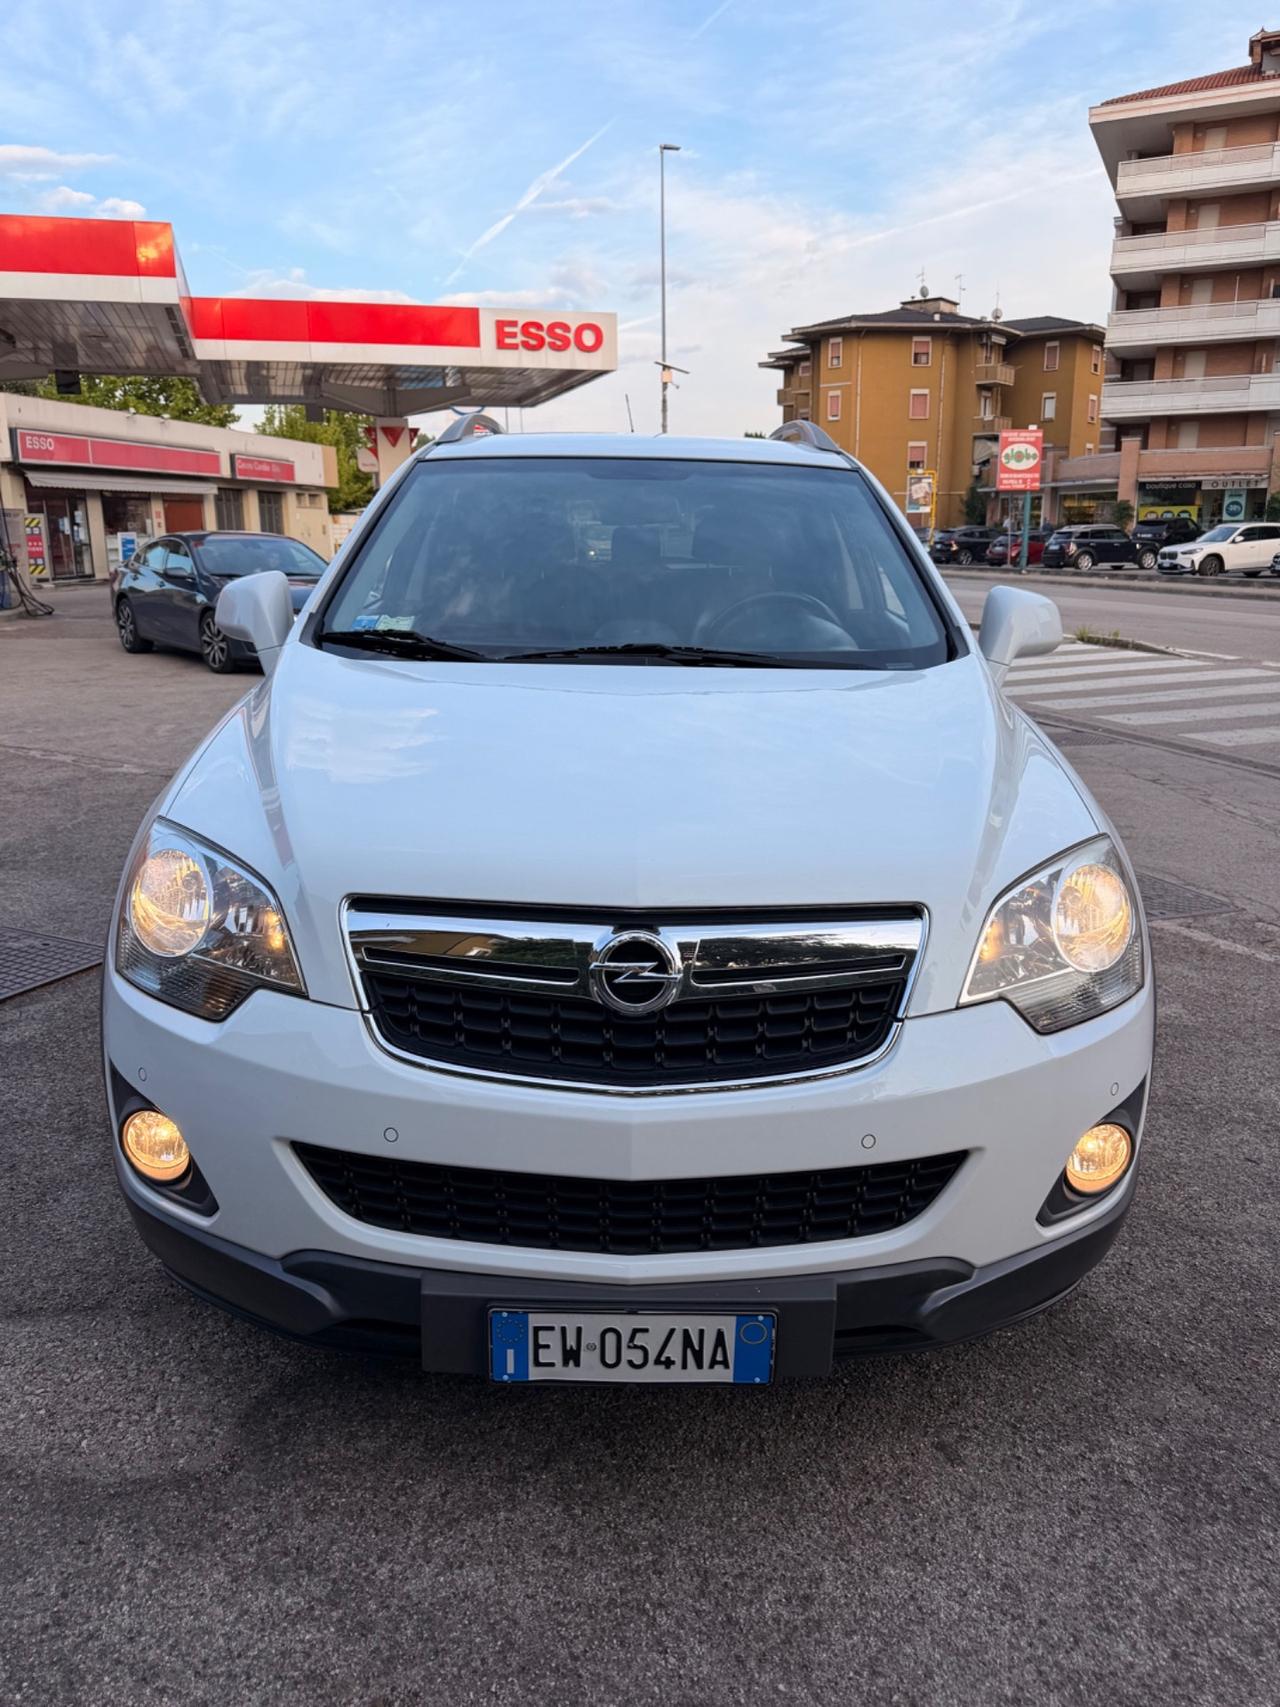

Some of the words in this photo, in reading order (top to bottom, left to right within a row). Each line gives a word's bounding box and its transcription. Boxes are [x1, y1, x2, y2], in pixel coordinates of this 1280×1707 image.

[495, 319, 603, 353] ESSO
[25, 435, 54, 451] ESSO
[1211, 480, 1259, 488] OUTLET
[532, 1325, 583, 1368] EW
[599, 1326, 731, 1371] 054NA
